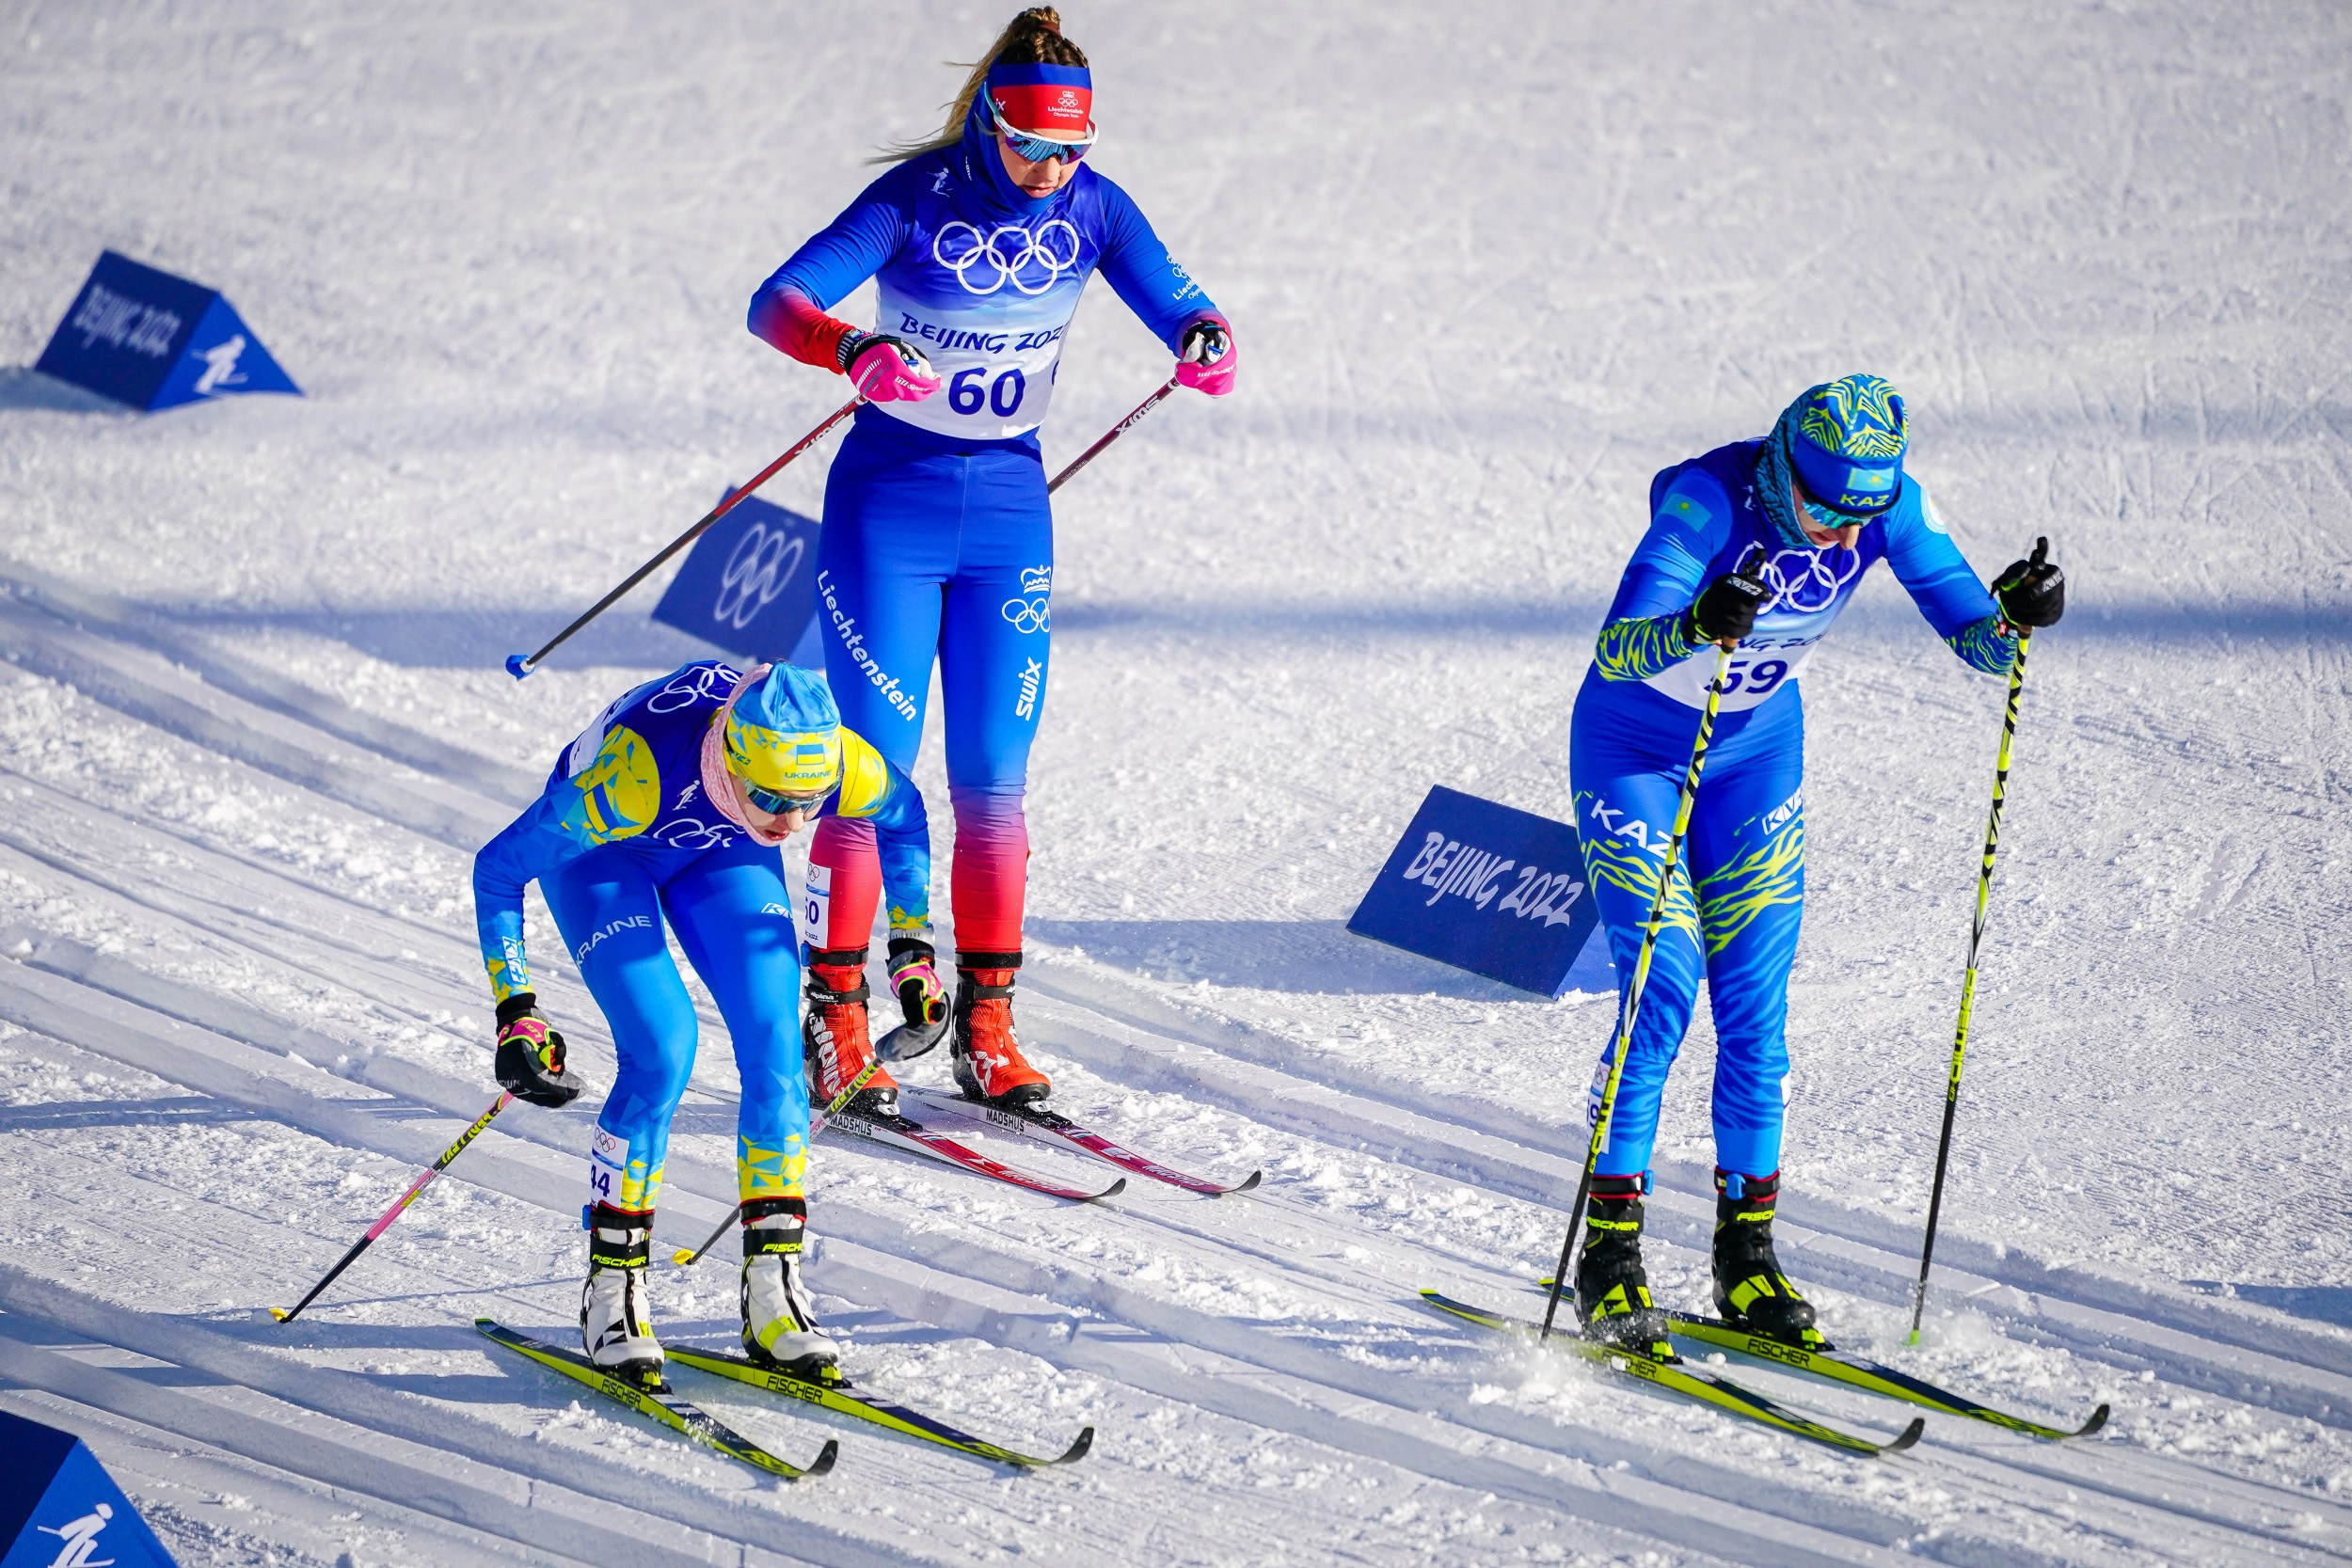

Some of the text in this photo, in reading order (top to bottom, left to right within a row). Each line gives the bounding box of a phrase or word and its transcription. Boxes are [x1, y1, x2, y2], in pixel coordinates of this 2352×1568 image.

[899, 311, 1066, 355] BEIJING 202
[948, 367, 1026, 418] 60
[1840, 494, 1889, 507] KAZ
[817, 570, 917, 721] Liechtenstein
[1016, 657, 1041, 721] swix
[1704, 659, 1788, 694] 59
[785, 769, 832, 779] UKRAINE
[1403, 832, 1584, 927] BEIJING 2022
[830, 1113, 872, 1136] MADSHUS
[985, 1108, 1025, 1132] MADSHUS
[592, 1253, 647, 1267] FISCHER
[1747, 1338, 1811, 1369] FISCHER
[601, 1378, 642, 1409] FISCHER
[767, 1374, 823, 1404] FISCHER
